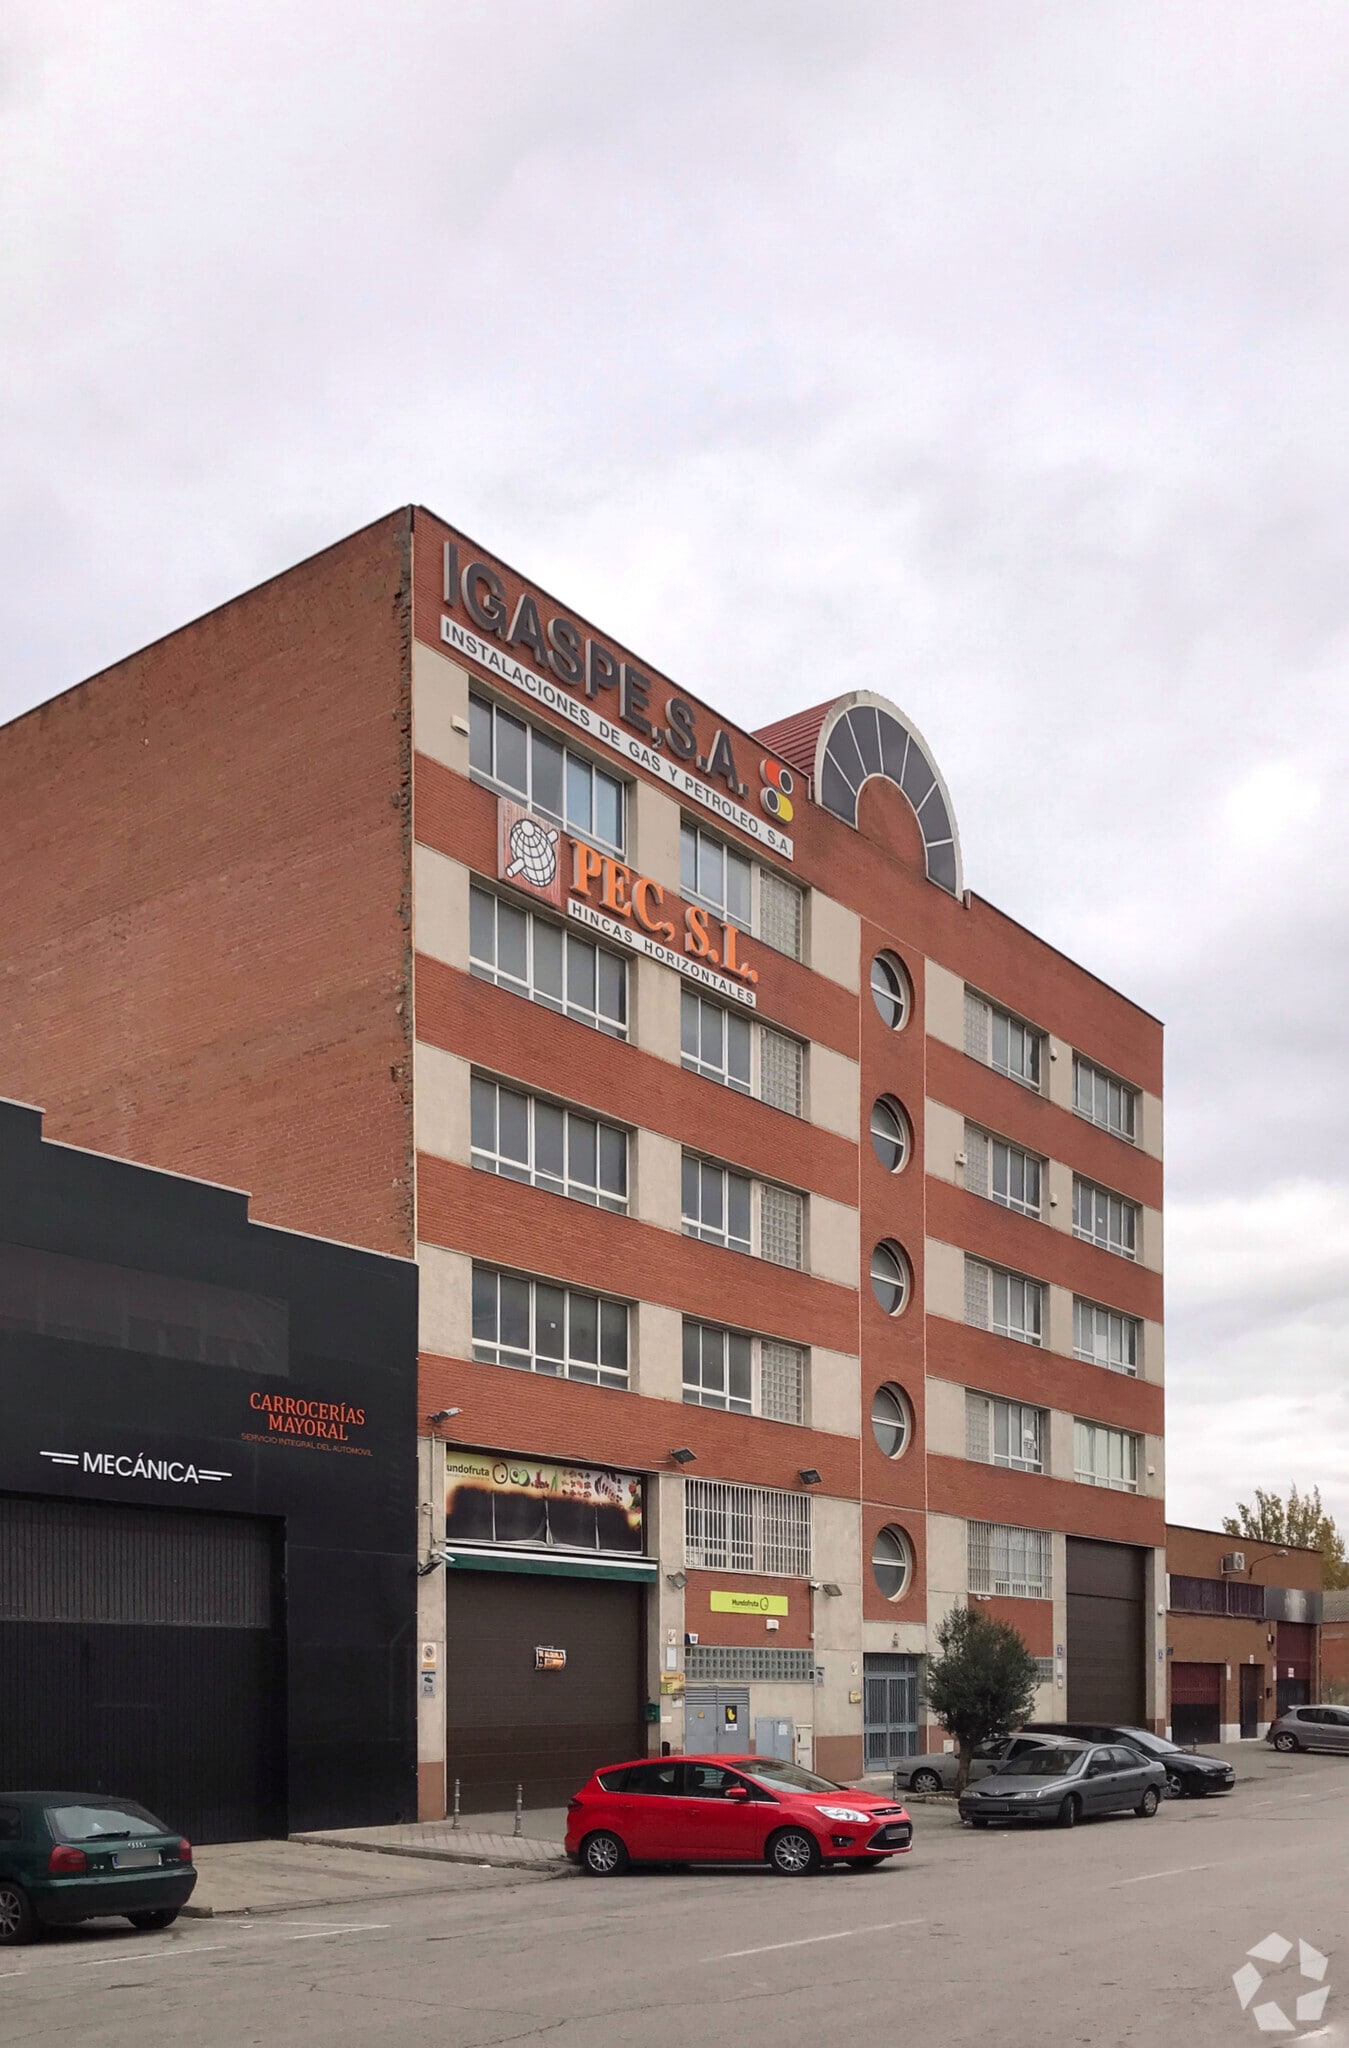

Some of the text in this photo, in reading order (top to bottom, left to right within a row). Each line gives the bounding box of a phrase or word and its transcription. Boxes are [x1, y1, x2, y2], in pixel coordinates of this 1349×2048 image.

[445, 621, 590, 728] INSTALACIONES
[599, 720, 621, 747] DE
[628, 741, 661, 773] GAS
[669, 765, 678, 782] Y
[767, 830, 793, 856] S.A.
[568, 839, 760, 985] PEC, S.L.
[572, 902, 754, 1004] HINCAS HORIZONTALES
[249, 1392, 365, 1425] CARROCERÍAS
[241, 1432, 278, 1444] SERVICIO
[279, 1438, 316, 1449] INTEGRAL
[317, 1442, 332, 1451] DEL
[268, 1413, 349, 1441] MAYORAL
[83, 1452, 199, 1484] MECÁNICA
[732, 1599, 759, 1607] Mundofruta
